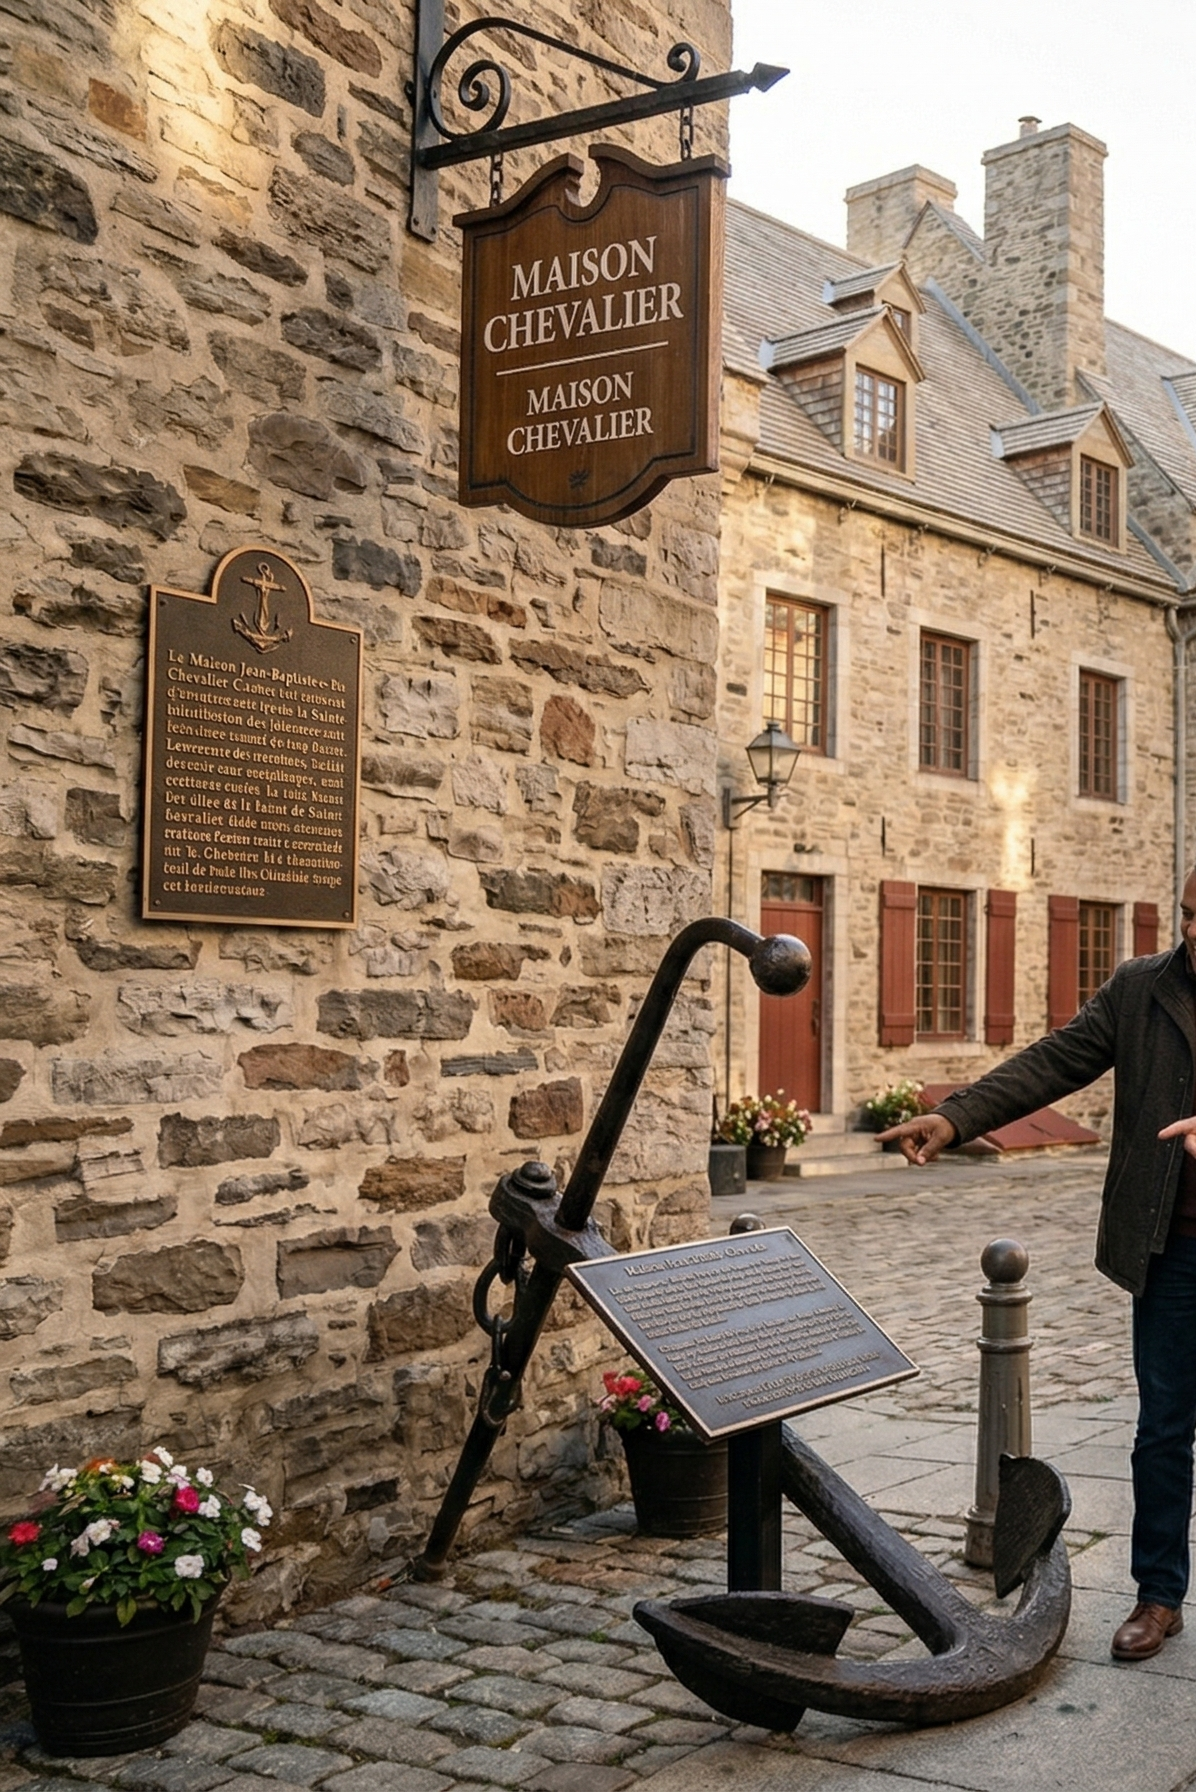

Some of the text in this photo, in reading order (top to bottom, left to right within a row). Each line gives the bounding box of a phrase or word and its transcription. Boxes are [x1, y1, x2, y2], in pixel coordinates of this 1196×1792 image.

[511, 235, 657, 301] MAISON
[483, 282, 684, 353] CHEVALIER
[526, 371, 634, 416] MAISON
[506, 407, 654, 455] CHEVALIER
[246, 715, 266, 731] des
[232, 747, 251, 761] des
[290, 804, 306, 818] de
[192, 862, 207, 876] de
